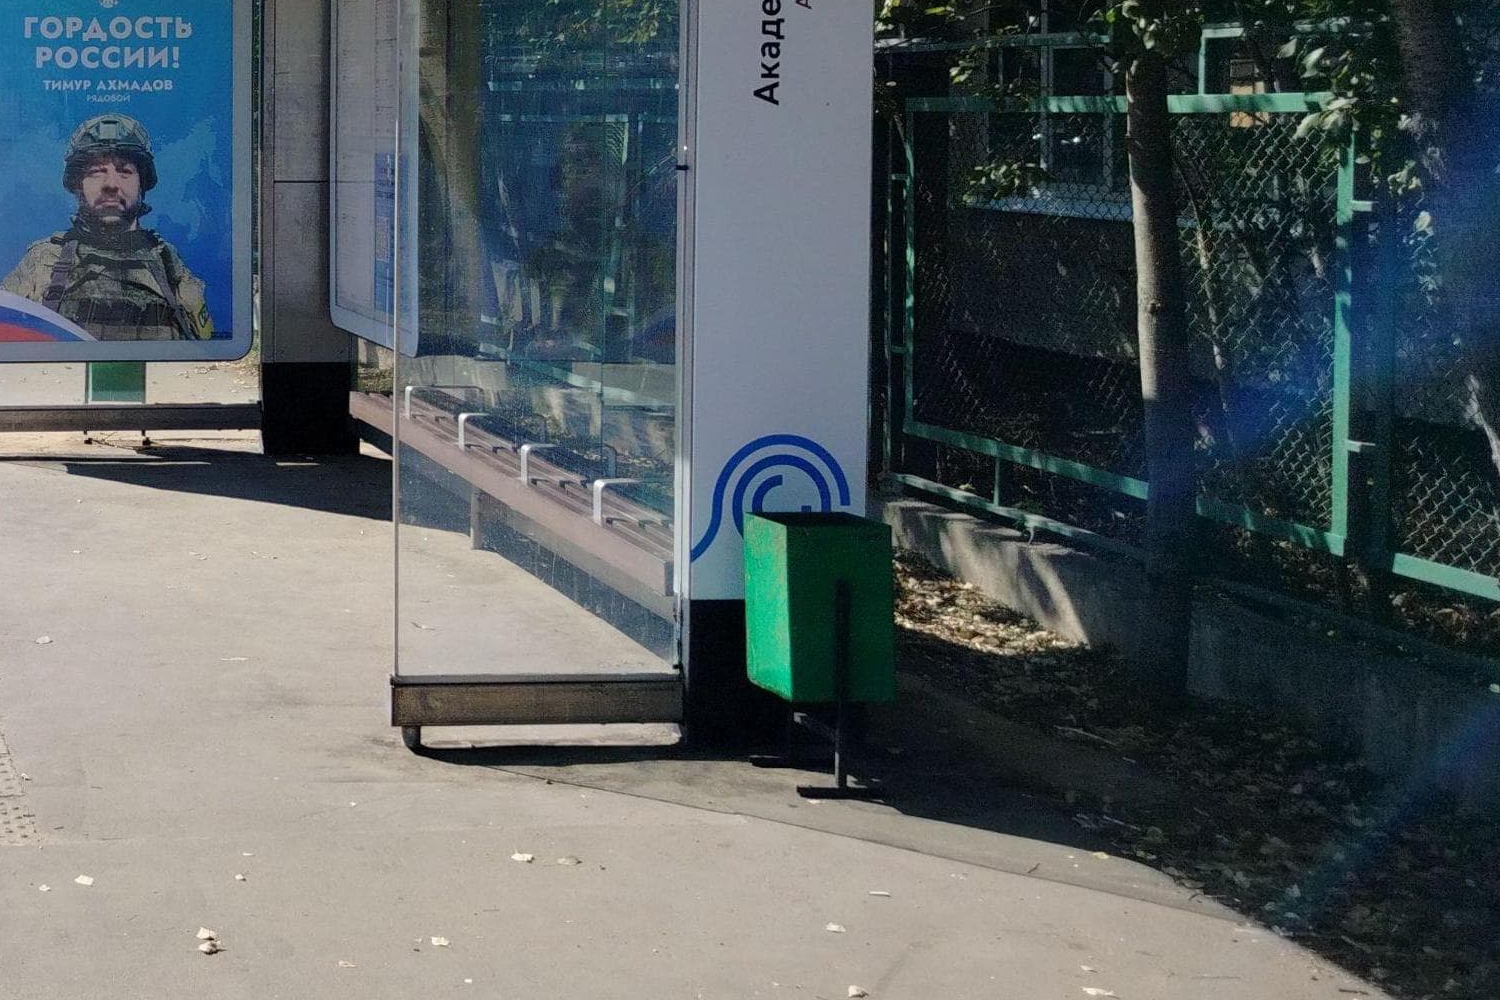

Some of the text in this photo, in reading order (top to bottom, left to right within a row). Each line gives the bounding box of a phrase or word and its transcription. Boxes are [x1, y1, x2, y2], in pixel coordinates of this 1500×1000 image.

[23, 16, 193, 42] ГОРДОСТЬ
[35, 46, 181, 69] РОССИИ!
[43, 79, 174, 92] ТИМУР АХМАДОВ
[86, 93, 131, 103] РЯДОВОЙ
